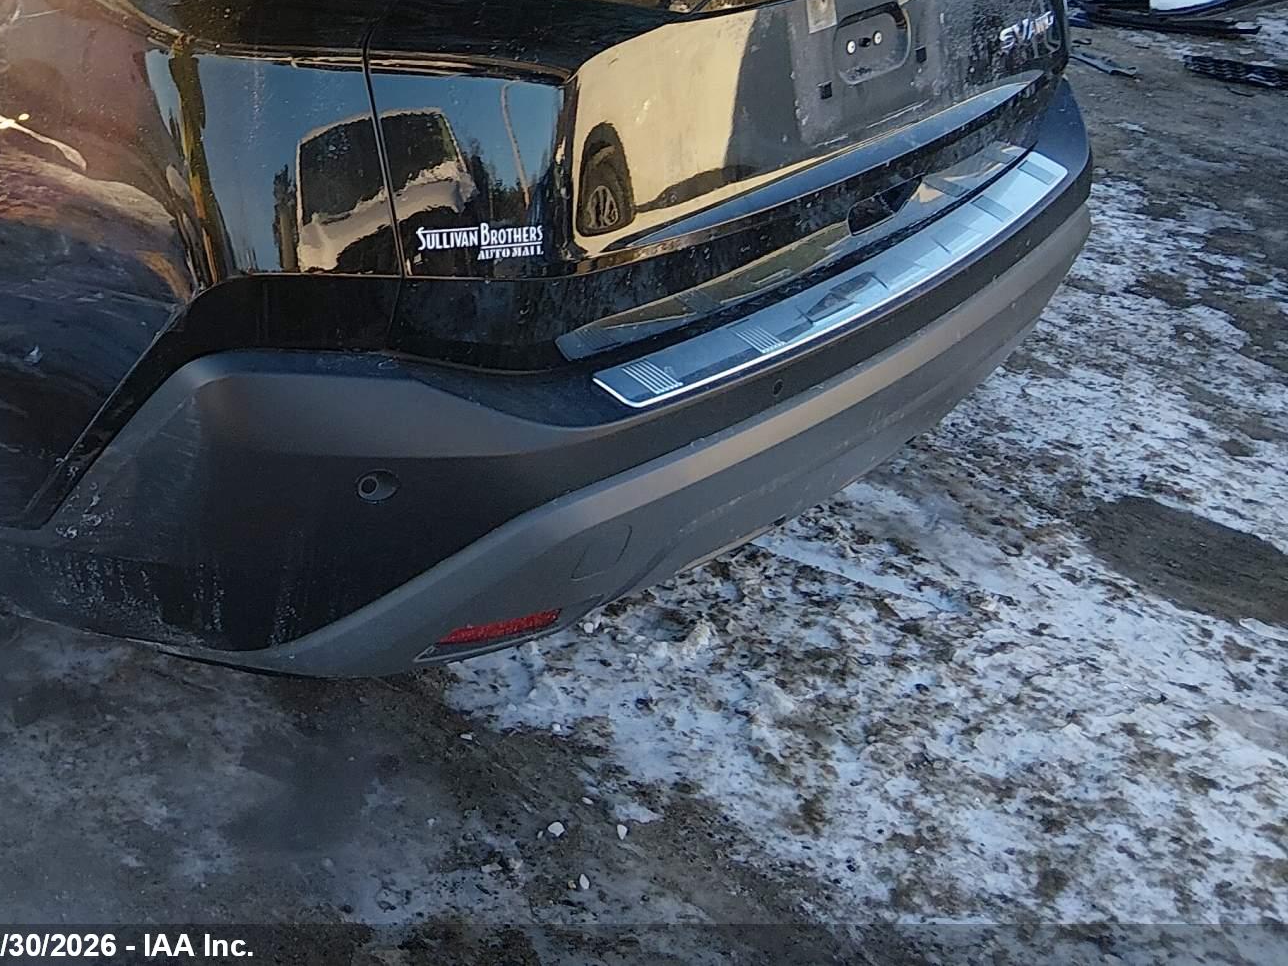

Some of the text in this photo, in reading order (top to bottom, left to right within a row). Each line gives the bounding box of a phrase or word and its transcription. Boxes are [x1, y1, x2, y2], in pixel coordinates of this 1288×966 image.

[999, 18, 1029, 50] SV
[415, 222, 544, 251] SULLIVAN BROTHERS
[476, 248, 511, 261] AUTO
